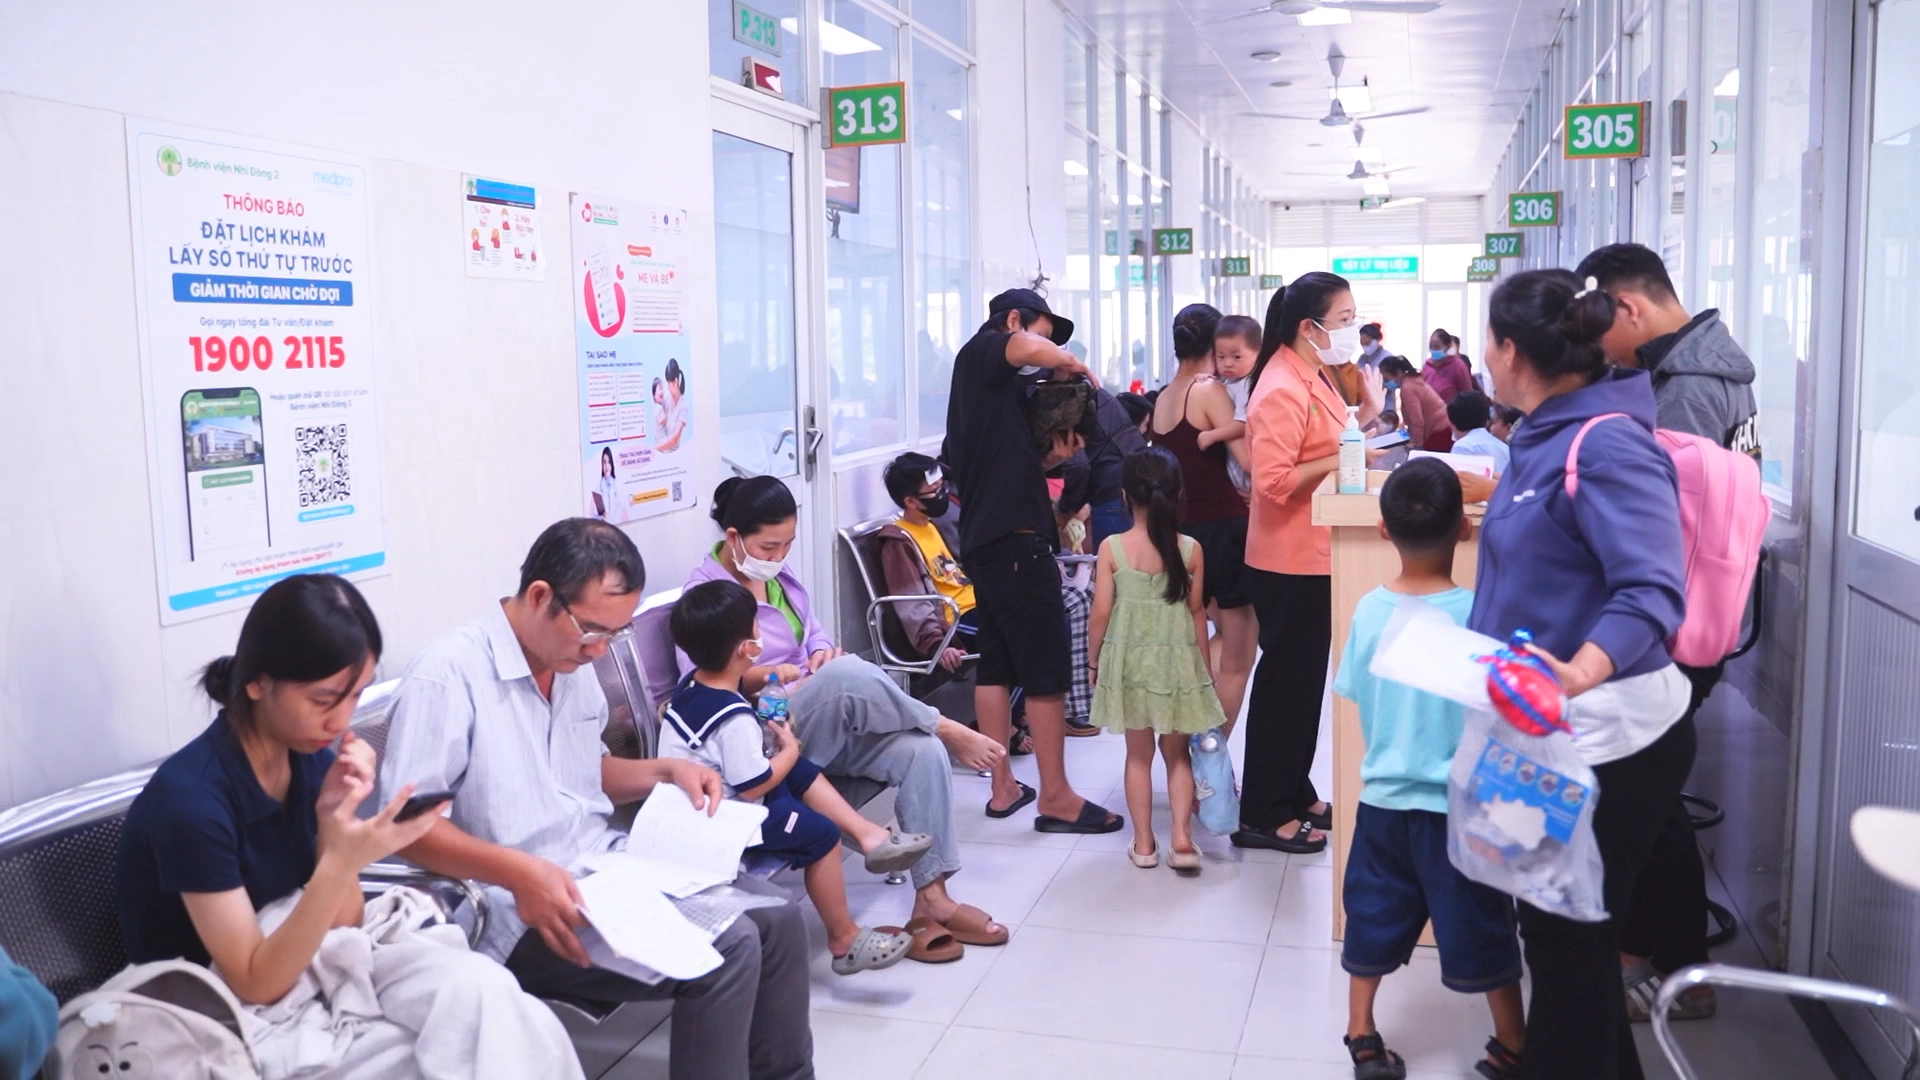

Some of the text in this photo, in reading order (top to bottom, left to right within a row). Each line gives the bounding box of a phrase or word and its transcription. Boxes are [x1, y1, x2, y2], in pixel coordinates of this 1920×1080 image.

[740, 9, 776, 47] P.313
[837, 95, 898, 136] 313
[1572, 114, 1634, 149] 305
[274, 170, 279, 180] 2
[313, 170, 353, 188] medpro
[223, 192, 305, 217] THÔNG BÁO
[1514, 199, 1553, 221] 306
[201, 217, 326, 248] ĐẶT LỊCH KHÁM
[1160, 233, 1190, 250] 312
[1489, 237, 1518, 254] 307
[169, 242, 353, 275] LẤY SỐ THỨ TỰ TRƯỚC
[1226, 260, 1248, 274] 311
[1473, 259, 1496, 272] 308
[190, 278, 340, 304] GIẢM THỜI GIAN CHỜ ĐỢI
[1264, 277, 1281, 287] 310
[216, 317, 236, 329] ngay
[189, 335, 346, 372] 1900 2115
